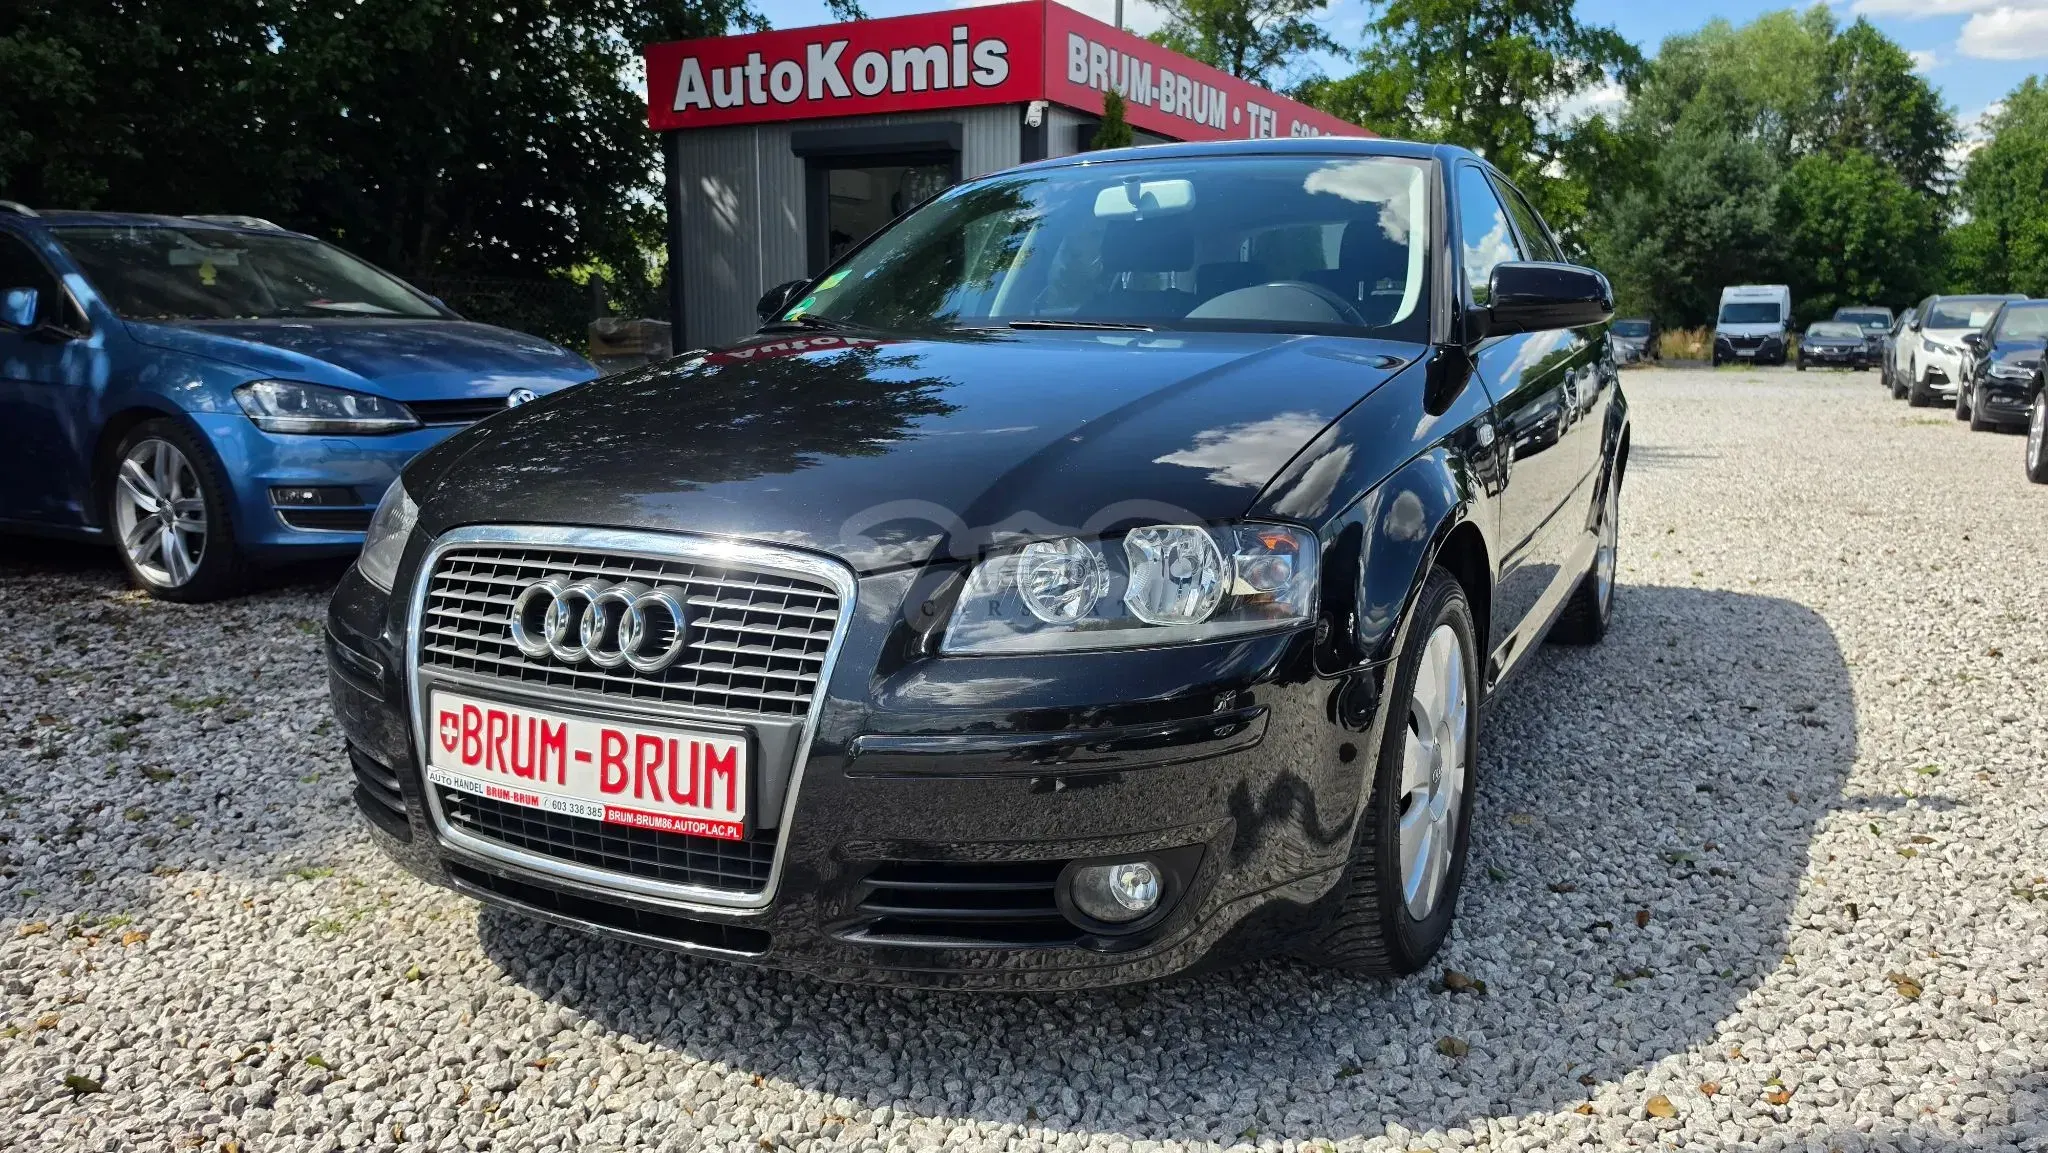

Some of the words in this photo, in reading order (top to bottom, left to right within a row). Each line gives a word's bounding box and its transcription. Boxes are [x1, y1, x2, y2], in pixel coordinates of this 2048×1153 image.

[673, 26, 1010, 111] AutoKomis
[1068, 32, 1227, 130] BRUM-BRUM
[429, 773, 453, 786] AUTO
[454, 777, 484, 794] HANDEL
[486, 785, 539, 807] BRUM-BRUM
[552, 800, 568, 811] 603
[569, 804, 585, 815] 338
[587, 807, 603, 818] 385
[608, 809, 739, 838] BRUM-BRUM86.AUTOPLAC.PL
